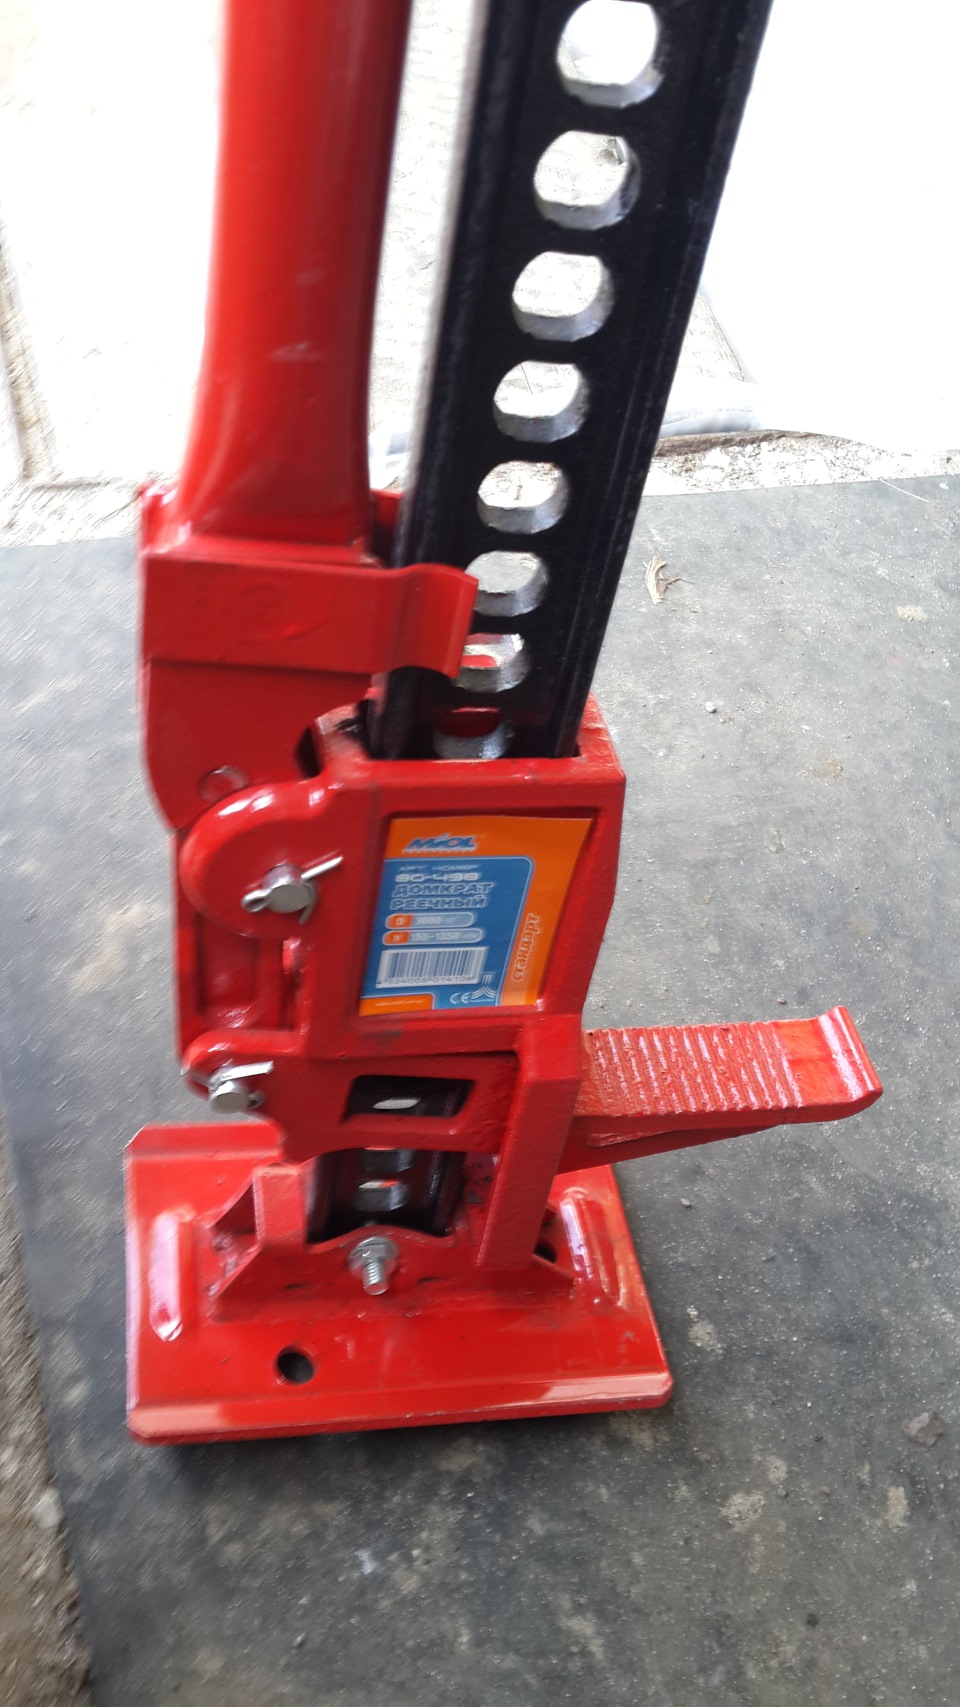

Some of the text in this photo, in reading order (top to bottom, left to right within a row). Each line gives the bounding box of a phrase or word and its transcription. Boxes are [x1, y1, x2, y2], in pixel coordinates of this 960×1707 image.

[392, 882, 495, 897] ДОМКРАТ
[390, 895, 487, 910] РЕЕЧНЫЙ
[511, 912, 541, 983] стандарт
